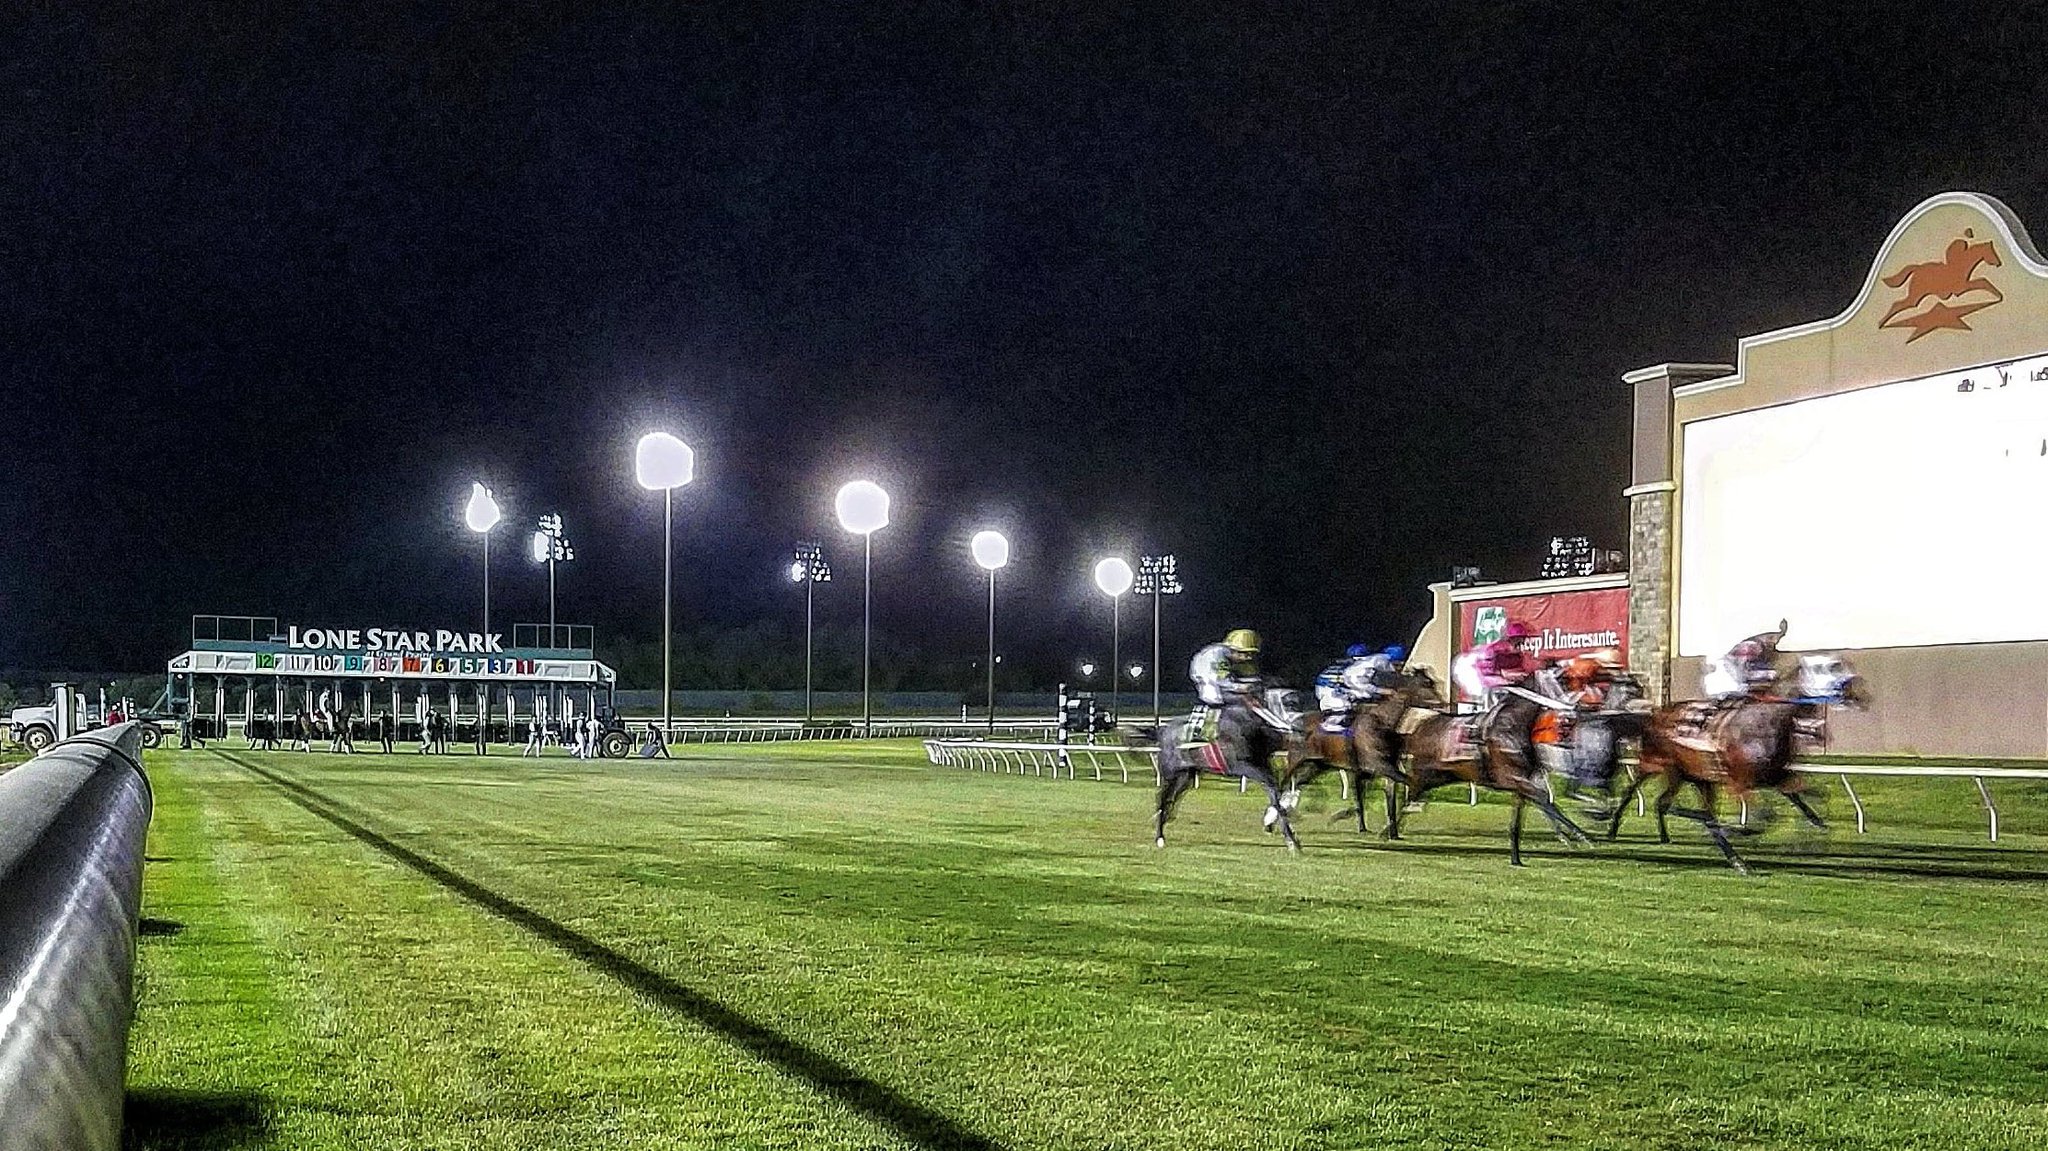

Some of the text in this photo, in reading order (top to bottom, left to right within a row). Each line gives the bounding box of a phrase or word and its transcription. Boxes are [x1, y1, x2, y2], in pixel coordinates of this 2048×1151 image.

[289, 625, 504, 653] LONE STAR PARK
[1519, 635, 1542, 658] eep
[1543, 628, 1554, 650] It
[259, 654, 272, 669] 12
[290, 655, 300, 670] 11
[317, 655, 332, 671] 10
[350, 657, 358, 670] 9
[379, 657, 387, 671] 8
[408, 658, 416, 671] 7
[435, 658, 445, 673] 6
[464, 659, 474, 674] 5
[492, 659, 502, 674] 3
